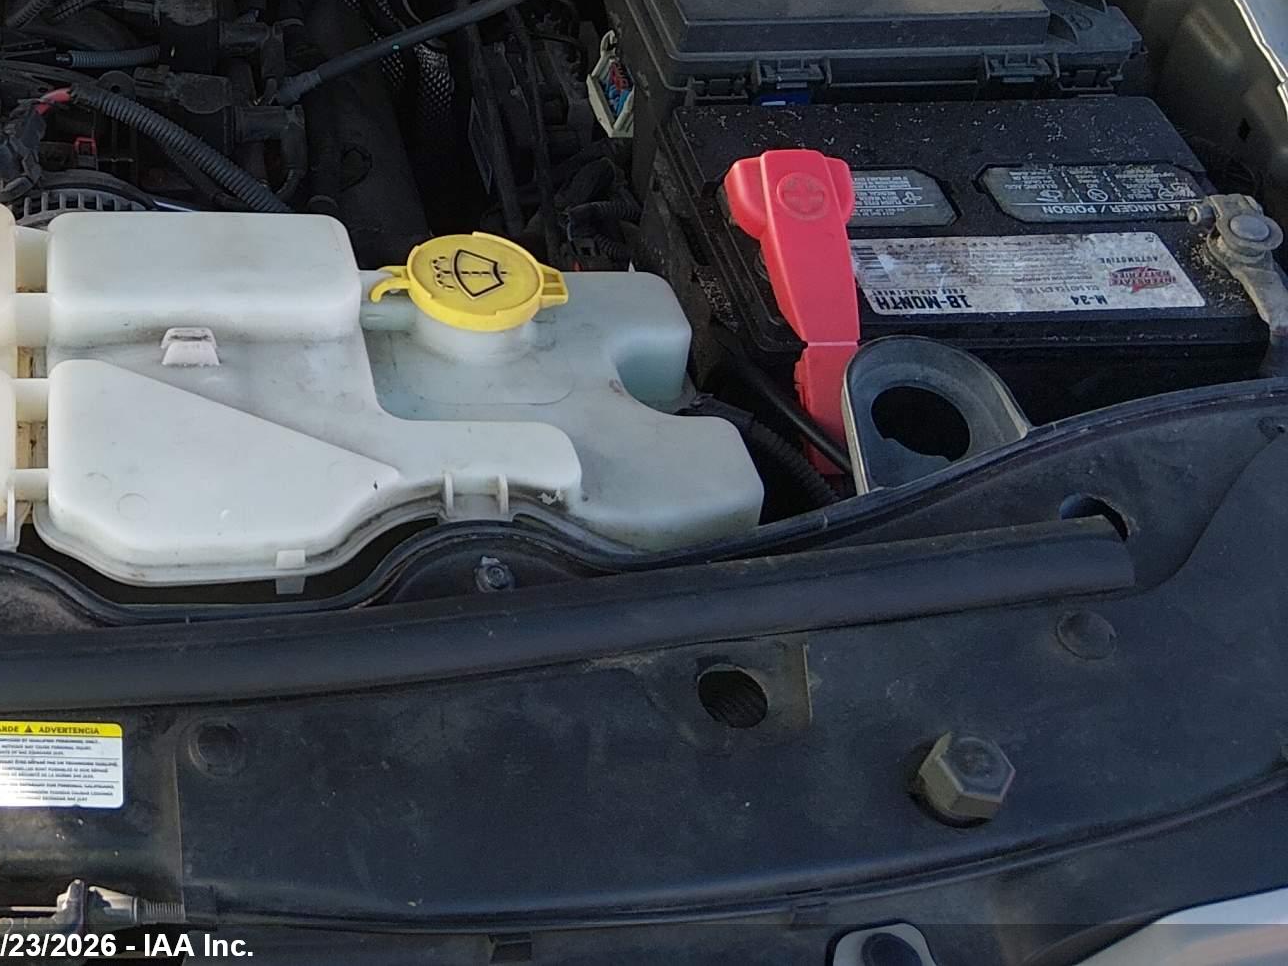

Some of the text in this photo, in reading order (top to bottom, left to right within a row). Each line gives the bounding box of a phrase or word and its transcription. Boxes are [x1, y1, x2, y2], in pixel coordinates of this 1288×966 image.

[1041, 205, 1096, 214] POISON
[1109, 204, 1168, 214] DANGER
[874, 294, 972, 309] 18-MONTH
[1070, 294, 1108, 305] M-34
[38, 726, 100, 735] ADVERTENCIA
